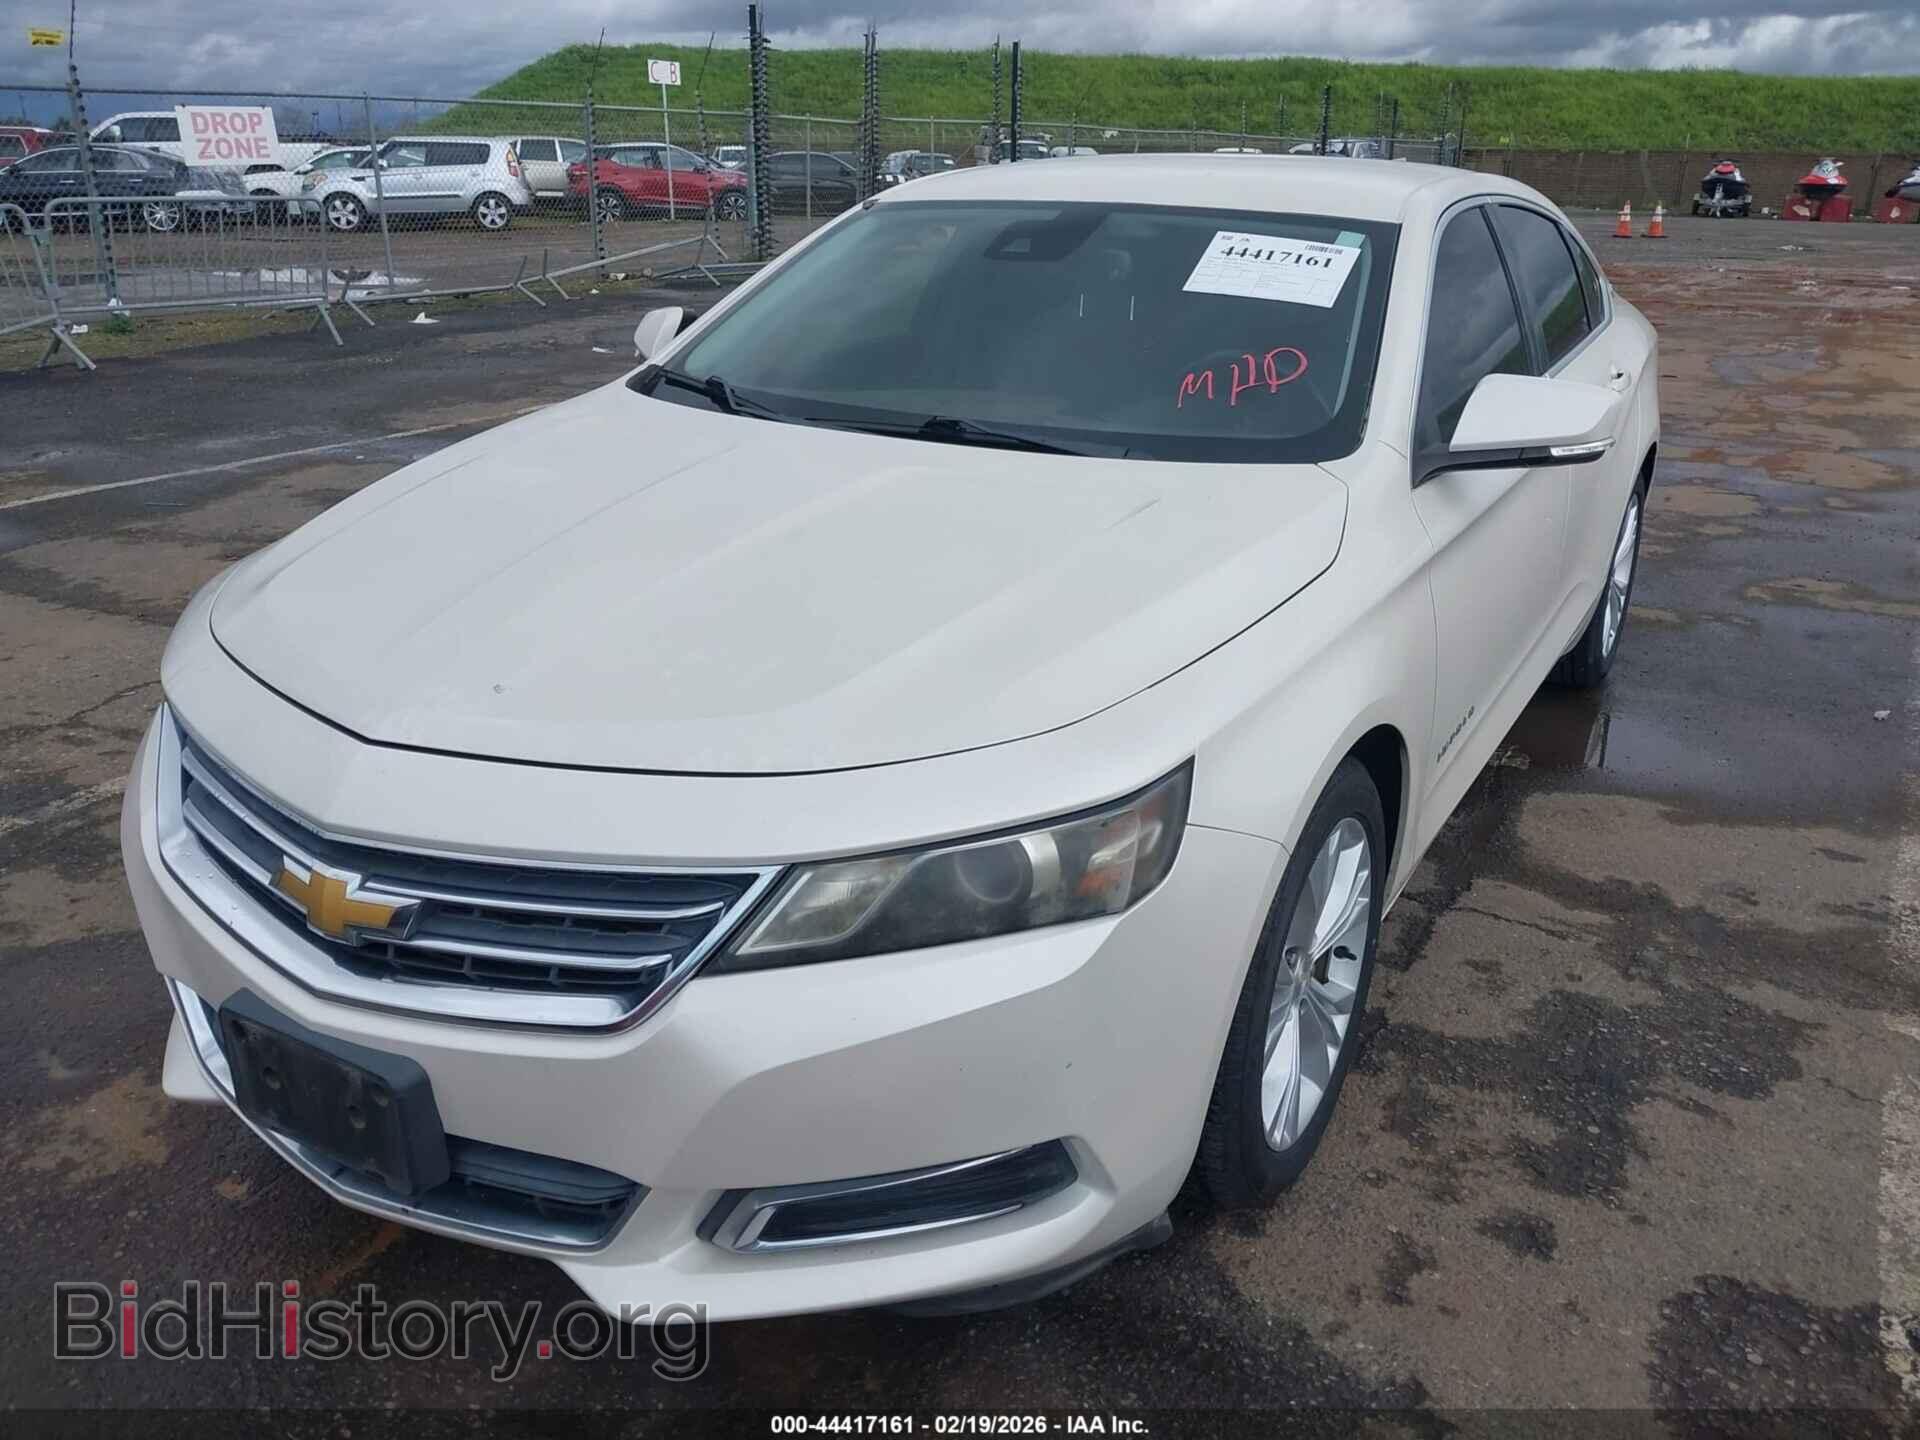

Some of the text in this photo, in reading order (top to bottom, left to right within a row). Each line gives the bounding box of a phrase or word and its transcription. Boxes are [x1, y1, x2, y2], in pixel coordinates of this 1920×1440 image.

[190, 111, 263, 134] DROP
[196, 137, 271, 159] ZONE
[1220, 245, 1333, 269] 44417161
